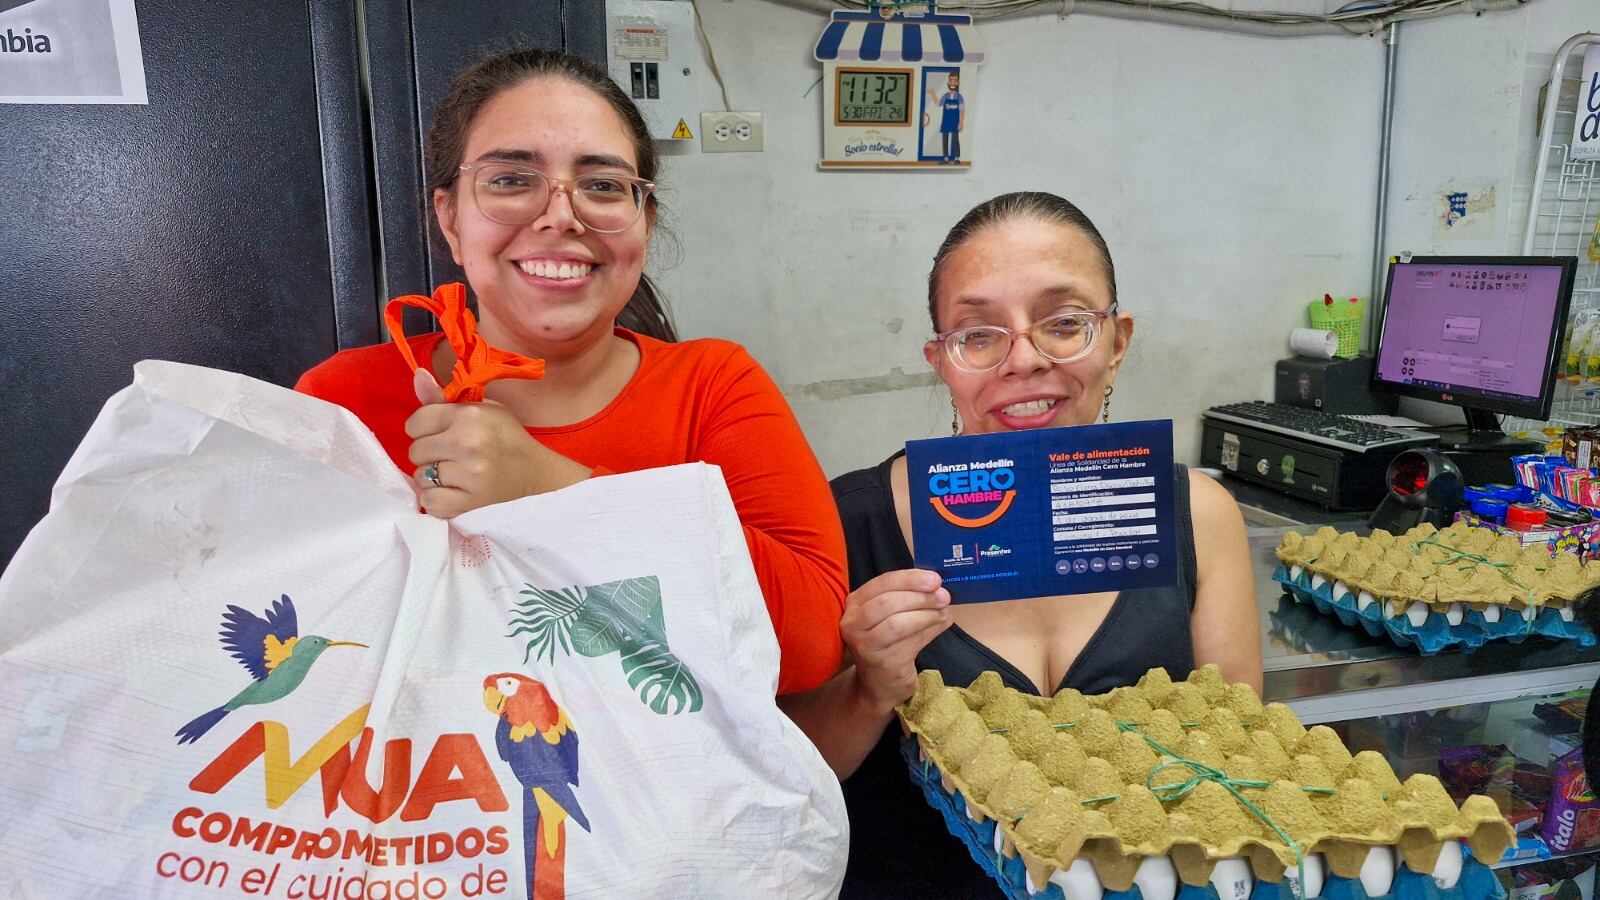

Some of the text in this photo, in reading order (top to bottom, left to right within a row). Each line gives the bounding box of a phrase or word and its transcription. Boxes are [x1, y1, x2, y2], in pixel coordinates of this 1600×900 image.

[844, 142, 904, 157] Socio estrella!
[1050, 447, 1150, 462] Vale de alimentación
[928, 458, 1014, 475] Alianza Medellín
[1051, 466, 1073, 474] Alianza
[1074, 463, 1102, 472] Medellín
[1103, 462, 1119, 470] Cero
[929, 468, 1015, 497] CERO
[944, 491, 1003, 506] HAMBRE
[981, 549, 1012, 557] Presentes
[172, 807, 509, 866] COMPROMETIDOS
[1550, 809, 1576, 851] italo
[156, 851, 507, 900] con el cuidado de
